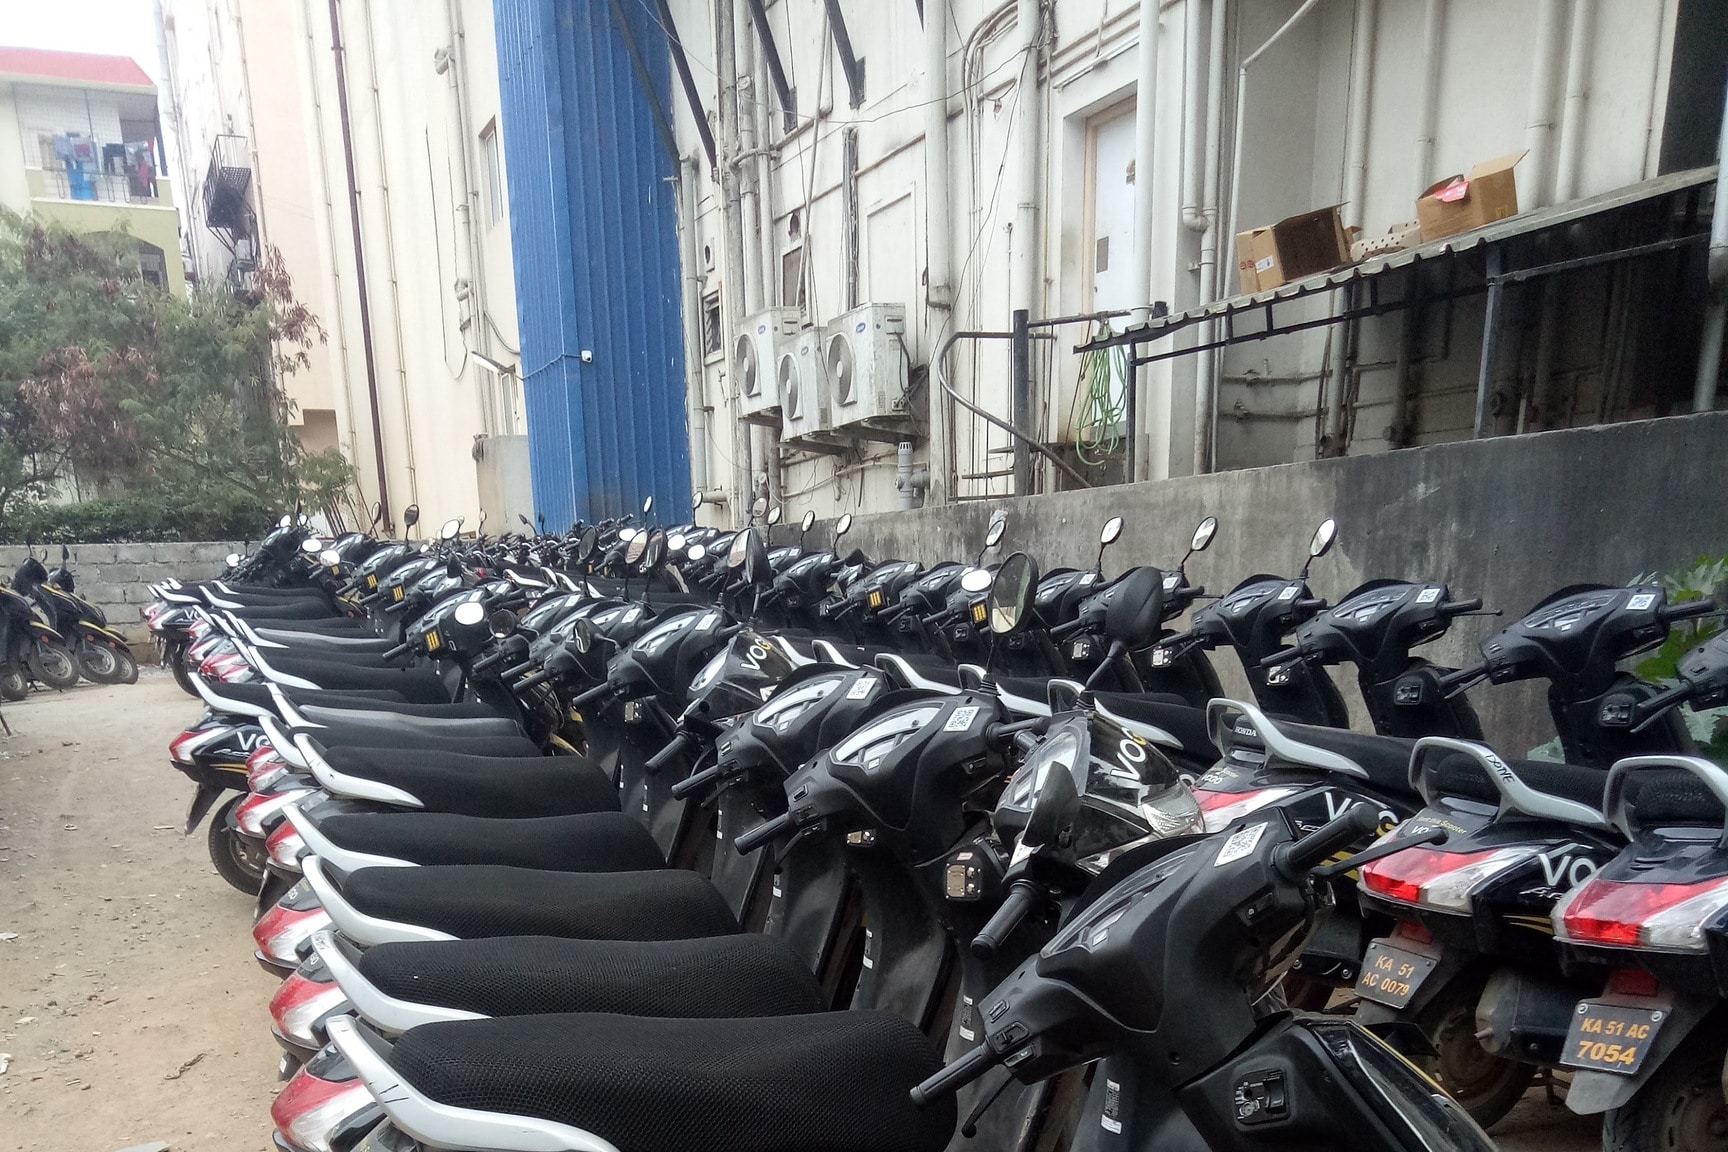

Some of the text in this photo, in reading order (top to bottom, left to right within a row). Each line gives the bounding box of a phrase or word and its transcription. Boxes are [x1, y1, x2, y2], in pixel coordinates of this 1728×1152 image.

[1374, 954, 1416, 979] KA 51
[1361, 971, 1411, 997] AC 0079
[1580, 1017, 1651, 1040] KA 51 AC
[1576, 1039, 1637, 1066] 7054
